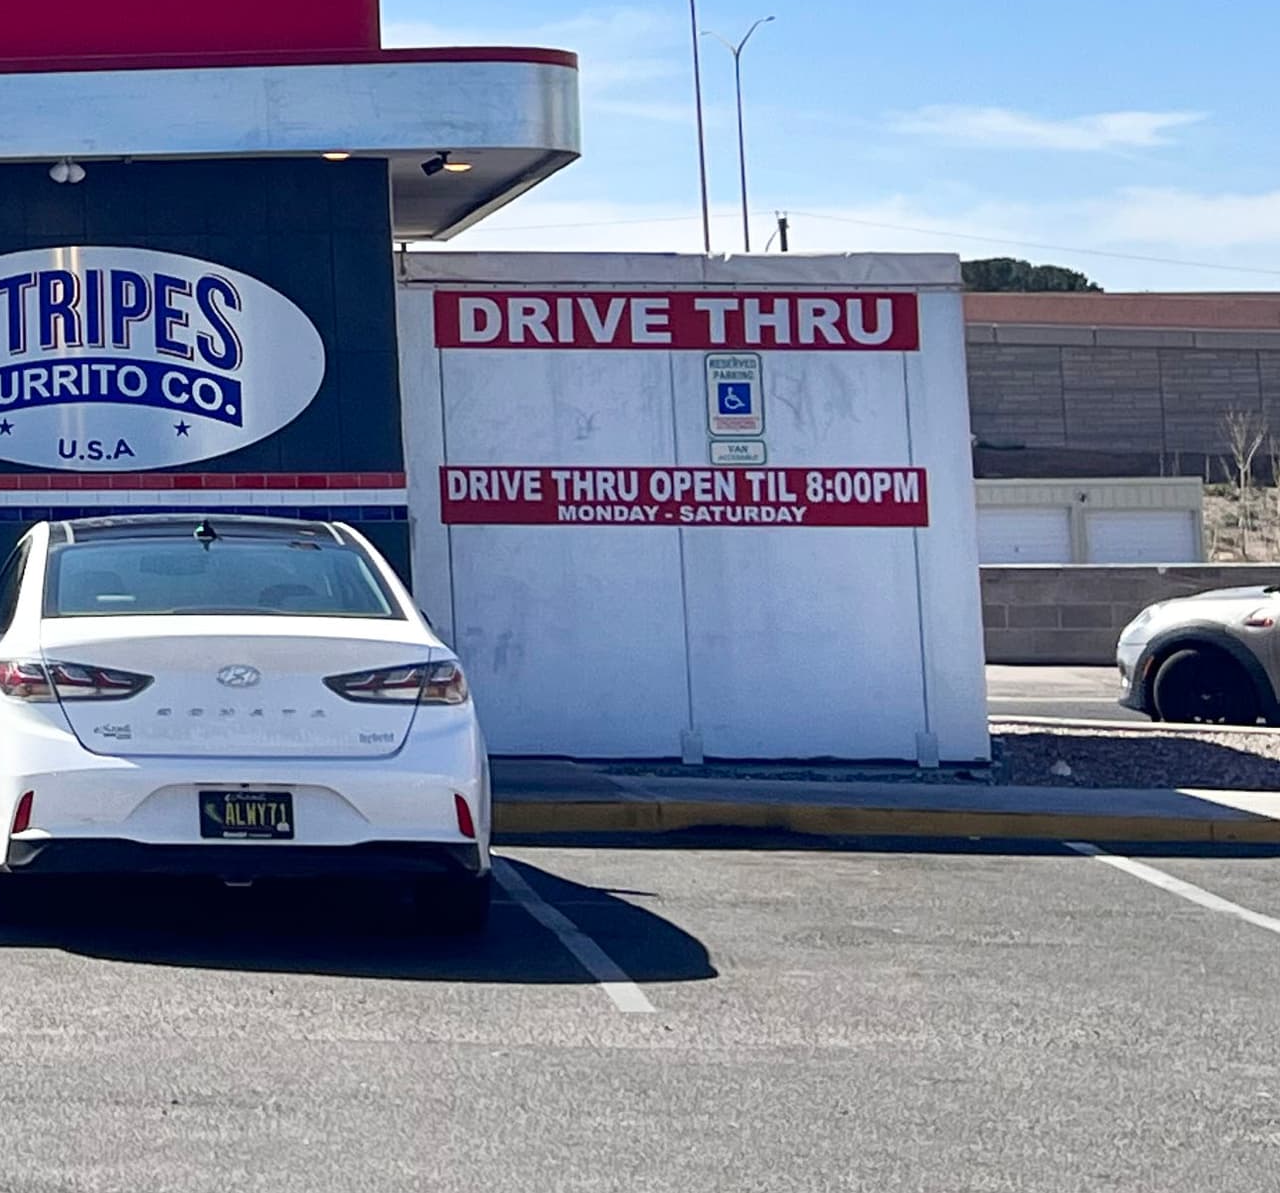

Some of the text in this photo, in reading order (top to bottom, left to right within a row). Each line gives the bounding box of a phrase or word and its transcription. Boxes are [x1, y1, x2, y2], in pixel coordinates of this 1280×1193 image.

[458, 297, 894, 345] DRIVE THRU
[161, 371, 237, 416] CO.
[58, 438, 135, 460] U.S.A
[728, 445, 749, 453] VAN
[448, 470, 920, 504] DRIVE THRU OPEN TIL 8:00PM
[558, 505, 659, 521] MONDAY
[679, 505, 807, 523] SATURDAY
